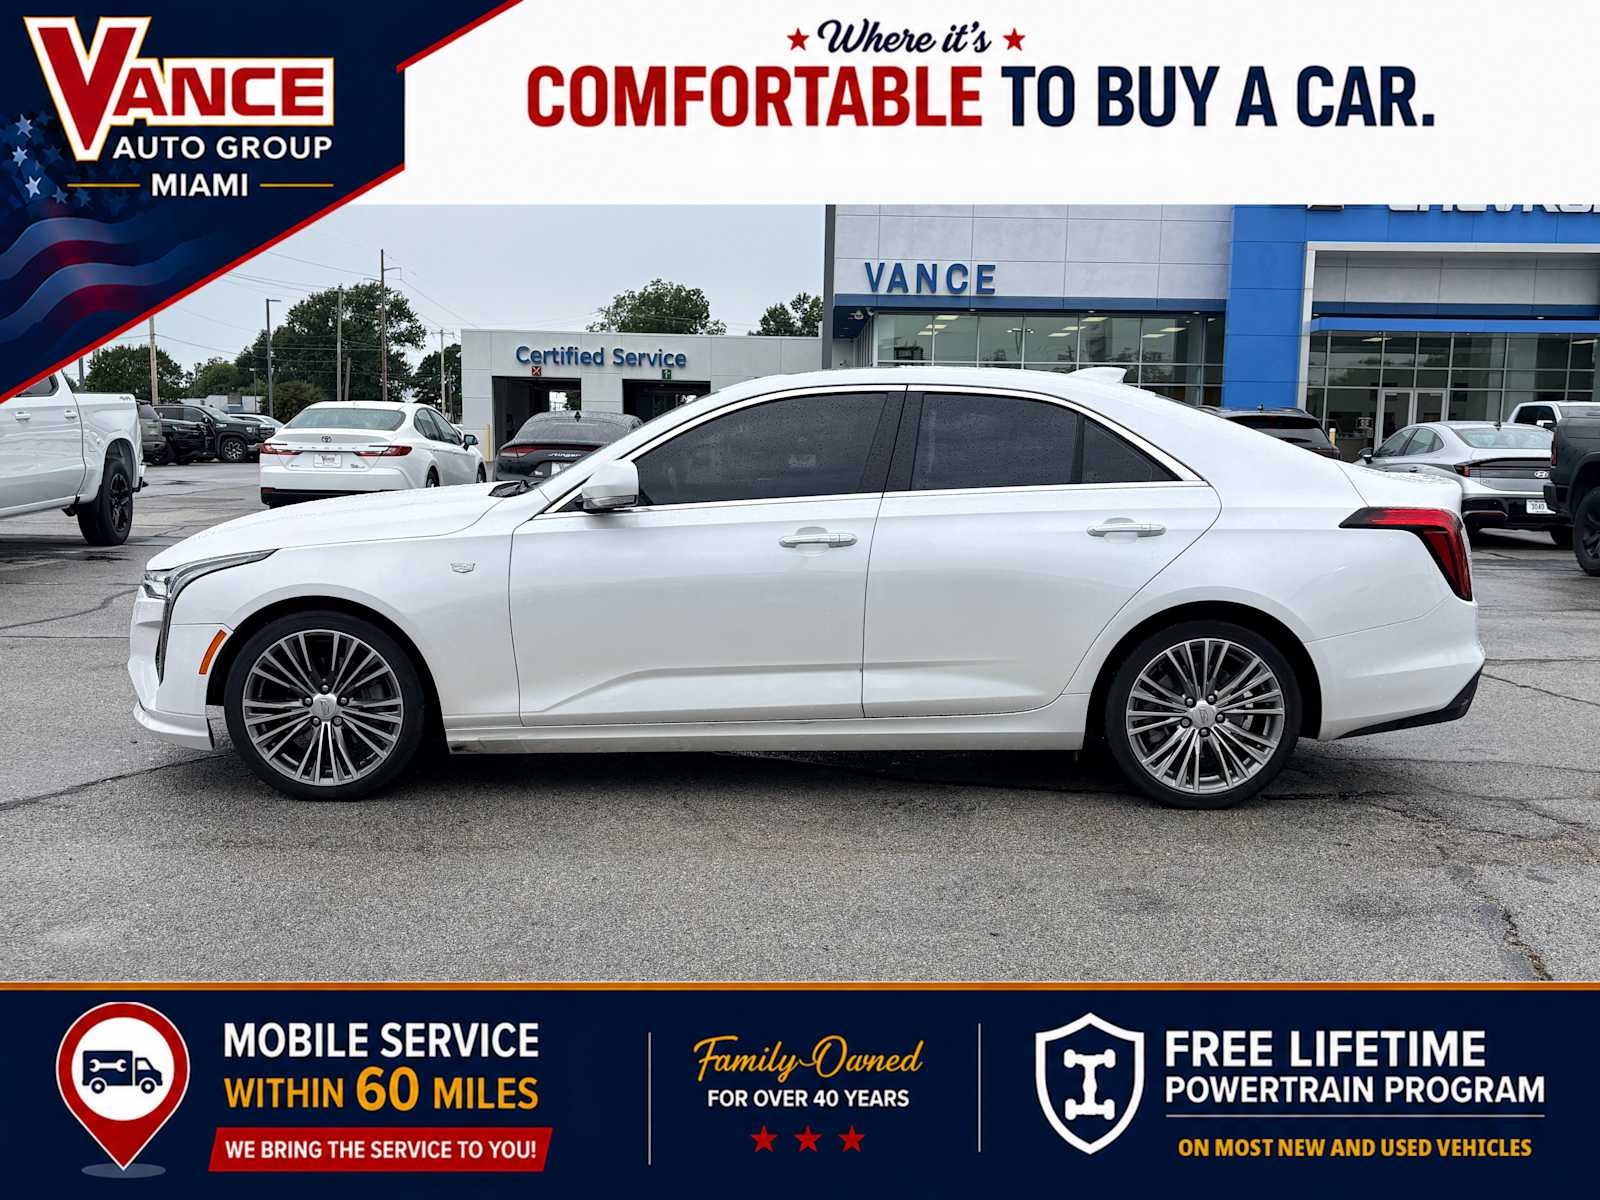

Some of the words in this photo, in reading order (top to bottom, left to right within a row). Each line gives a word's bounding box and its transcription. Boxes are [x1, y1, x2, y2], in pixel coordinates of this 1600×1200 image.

[864, 262, 996, 295] VANCE
[515, 345, 605, 366] Certified
[613, 348, 687, 368] Service
